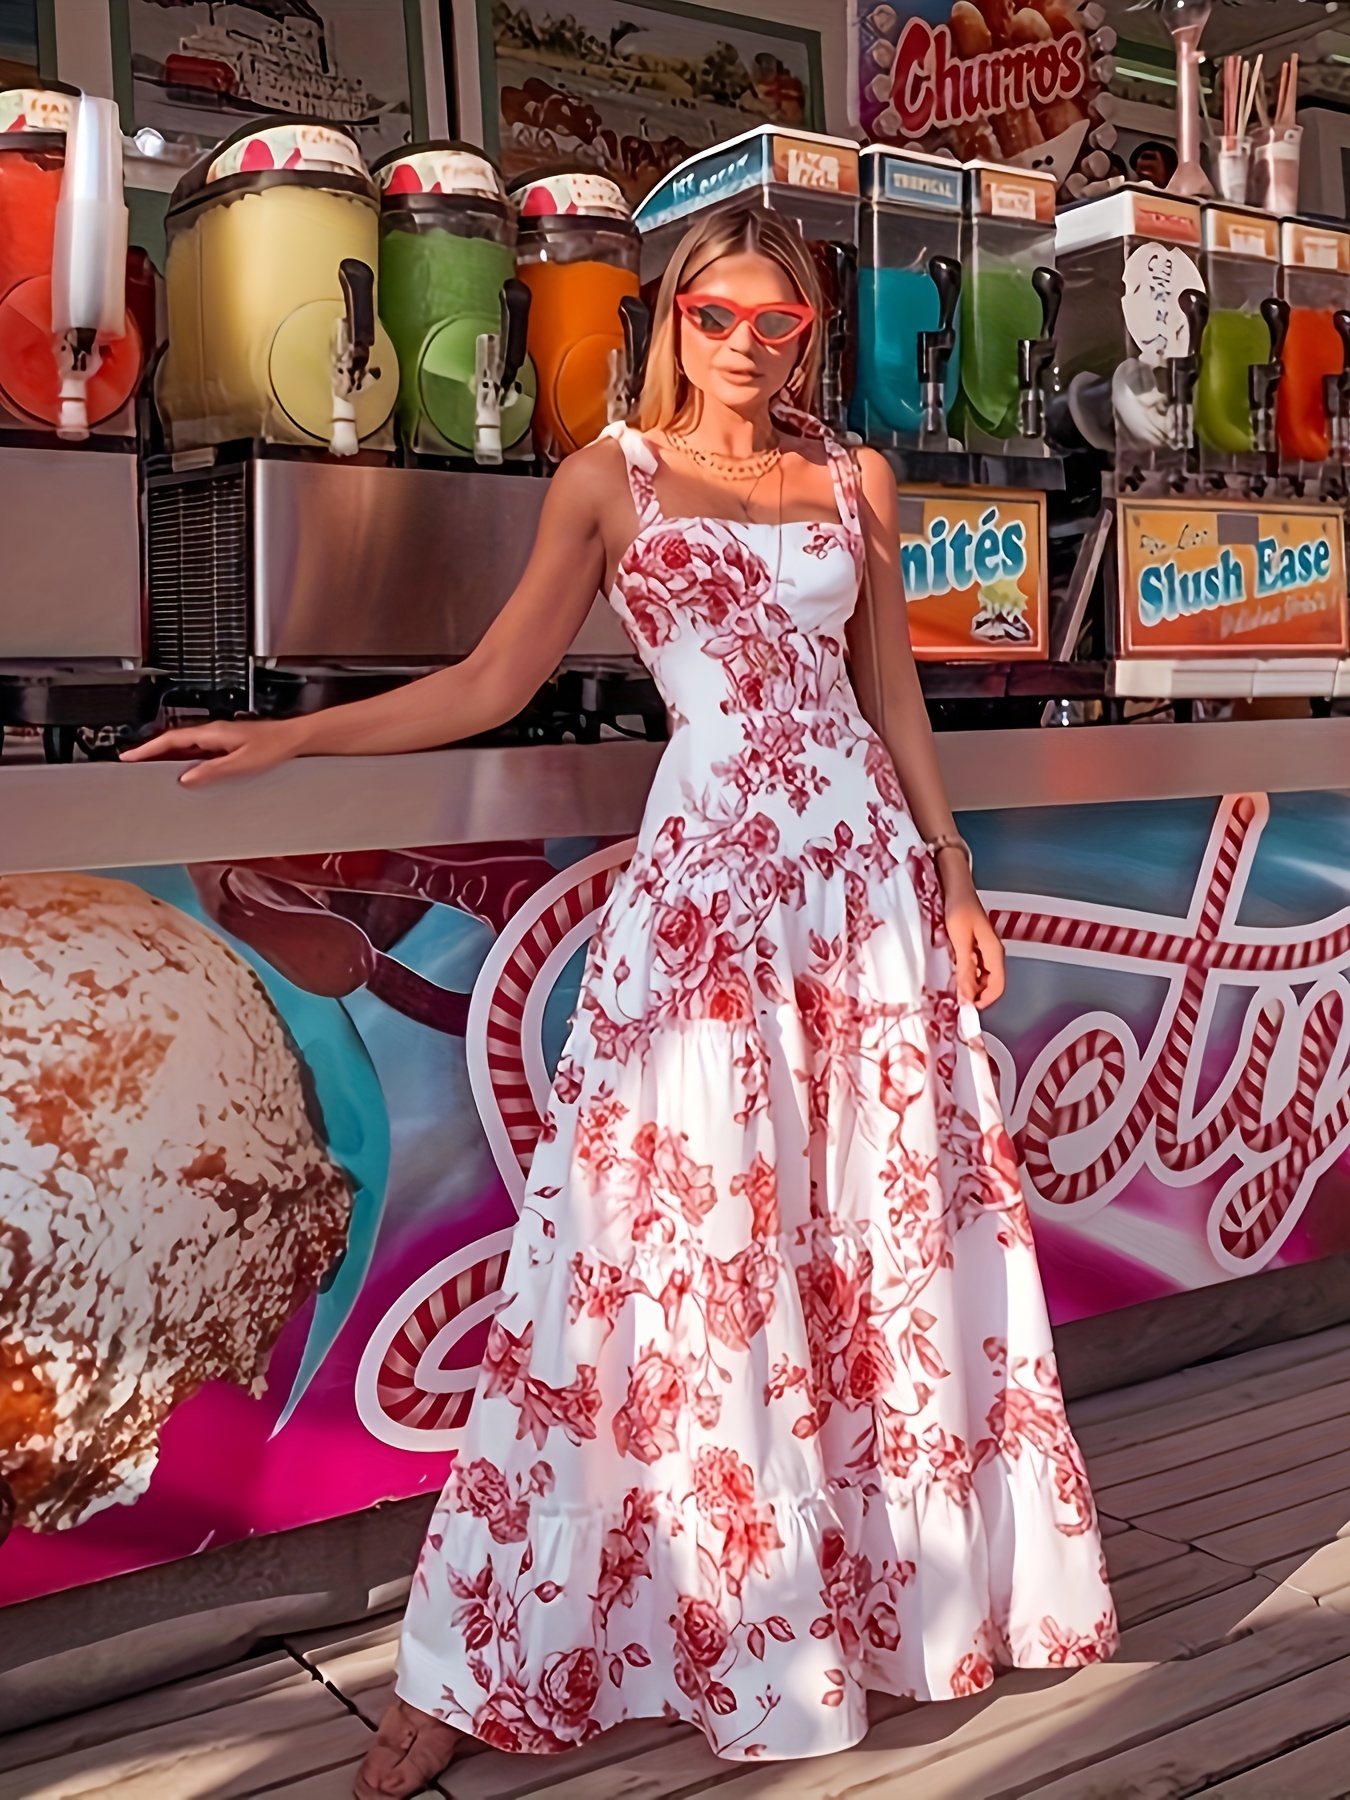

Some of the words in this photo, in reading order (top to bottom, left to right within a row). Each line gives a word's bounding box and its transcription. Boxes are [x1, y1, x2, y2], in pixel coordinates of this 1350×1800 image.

[893, 18, 1084, 137] Churros
[901, 507, 1027, 602] nités
[1139, 549, 1246, 627] Slush
[1254, 536, 1330, 598] Ease
